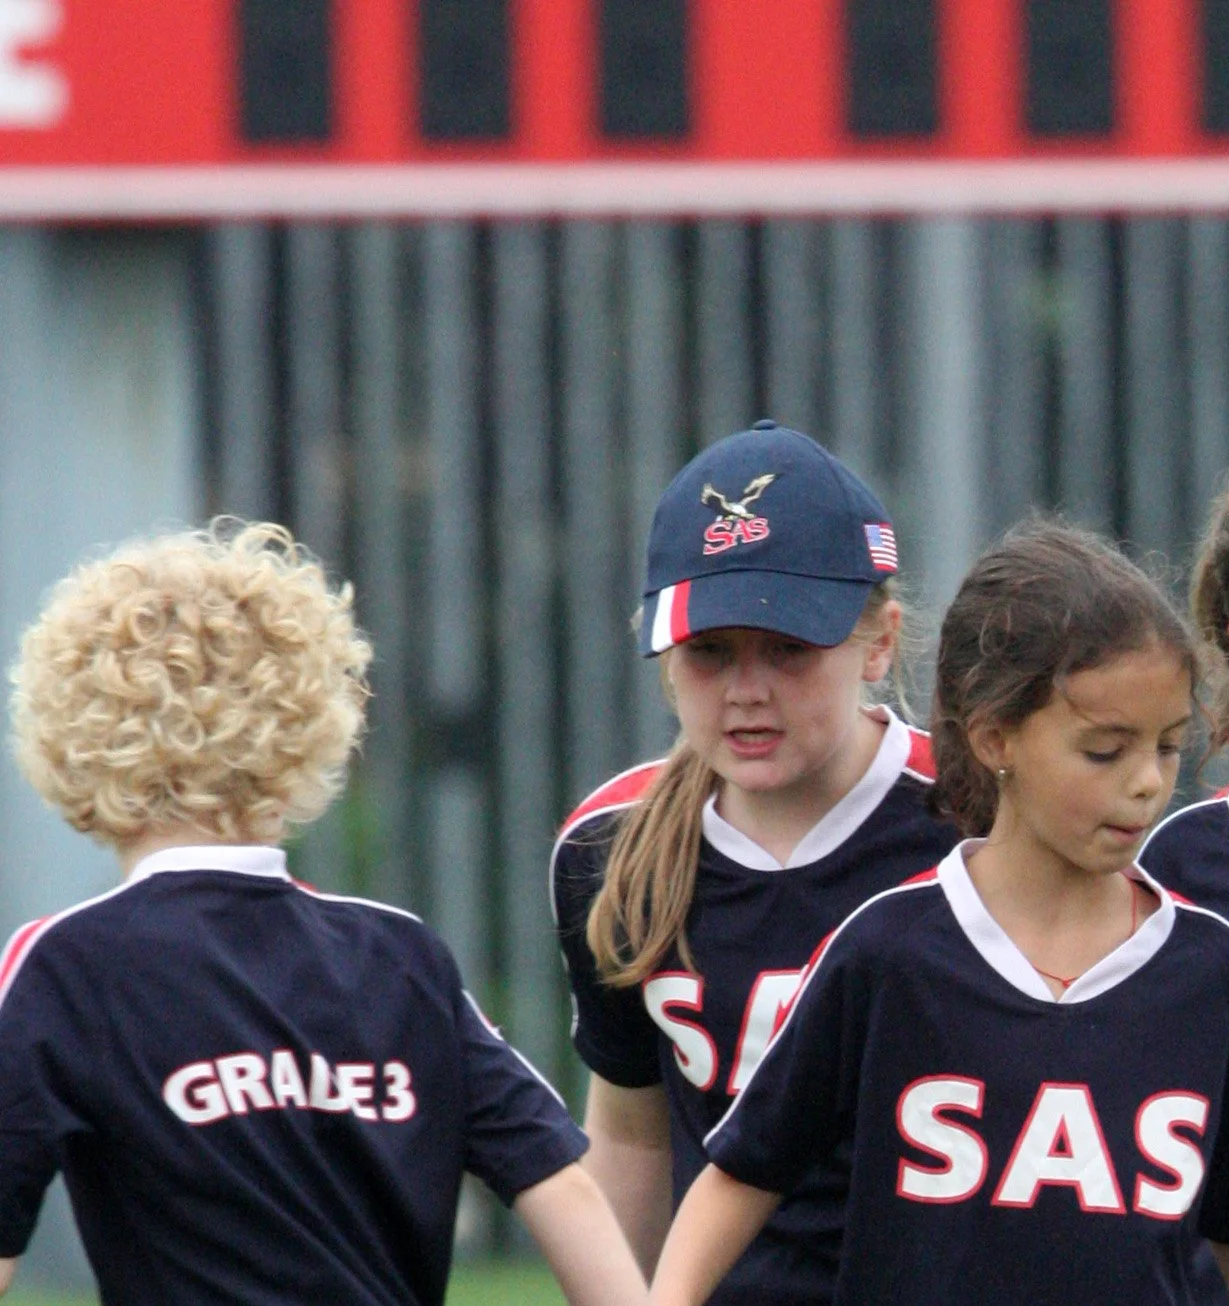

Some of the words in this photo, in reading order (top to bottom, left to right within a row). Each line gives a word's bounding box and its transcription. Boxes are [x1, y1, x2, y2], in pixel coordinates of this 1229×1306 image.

[703, 517, 770, 555] SAS
[642, 969, 808, 1096] SA
[895, 1073, 1210, 1221] SAS
